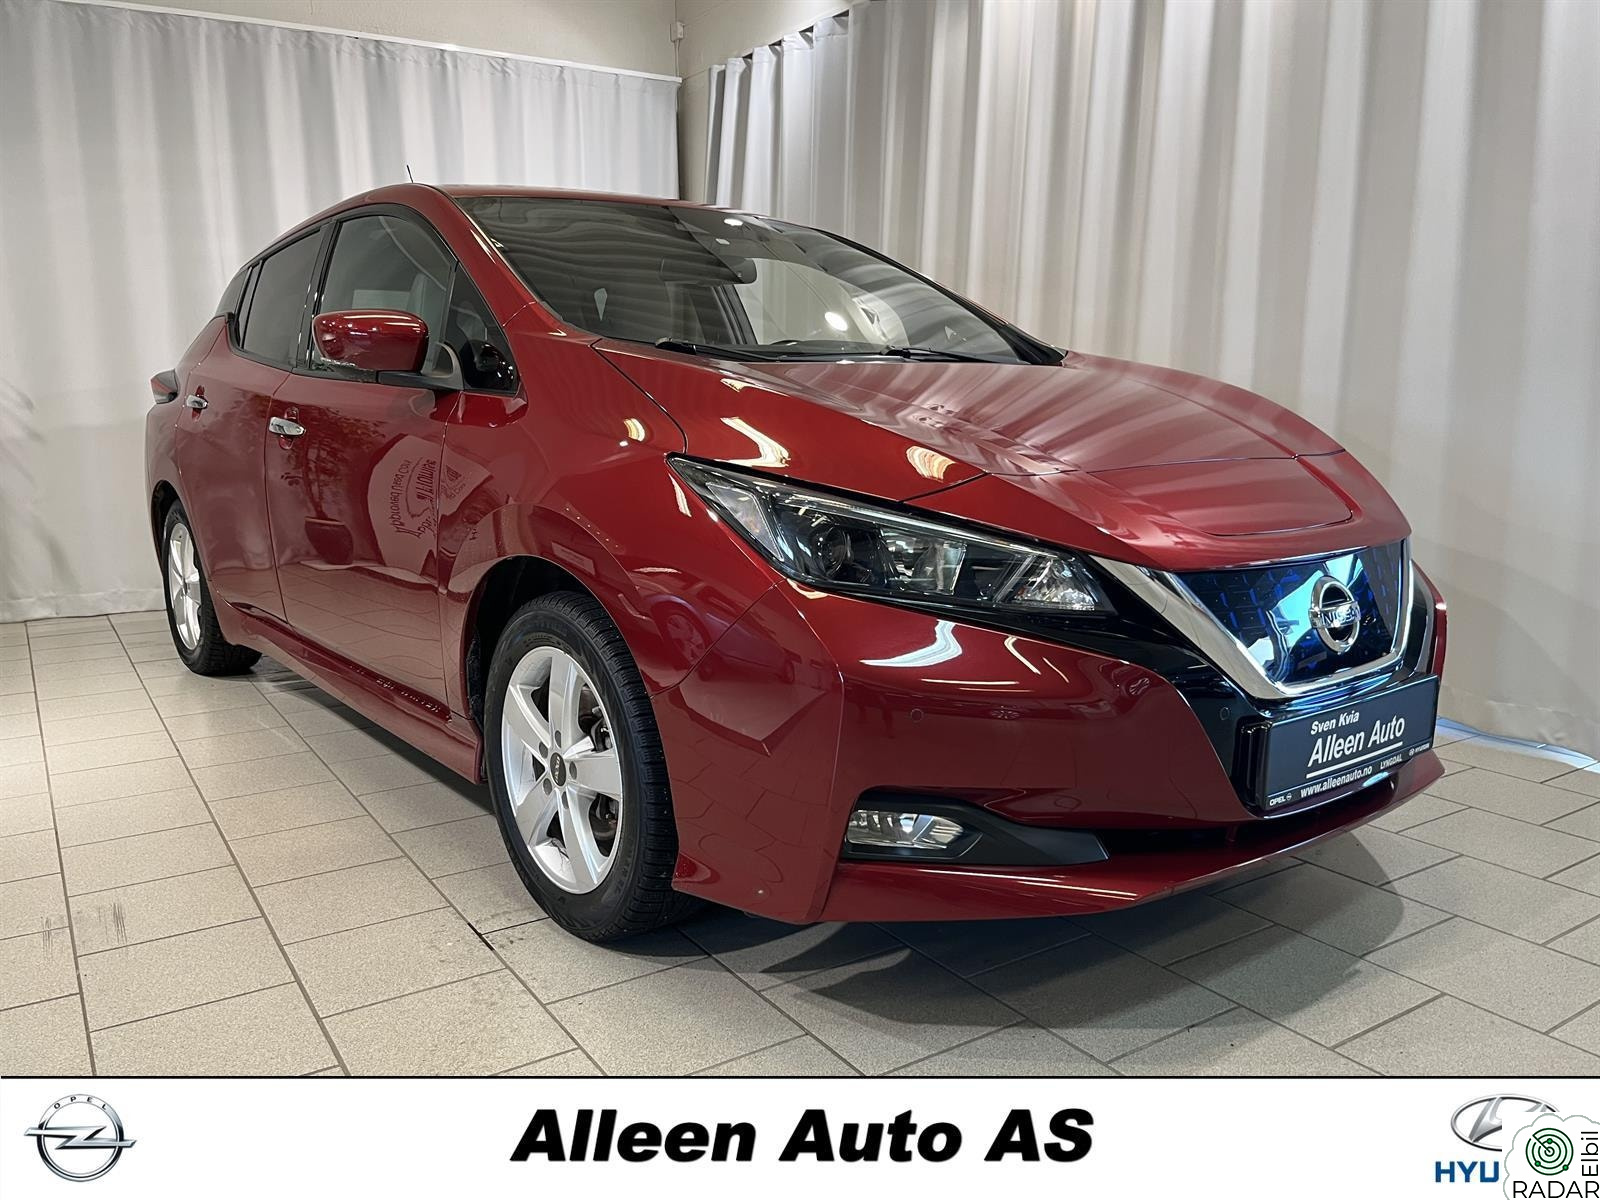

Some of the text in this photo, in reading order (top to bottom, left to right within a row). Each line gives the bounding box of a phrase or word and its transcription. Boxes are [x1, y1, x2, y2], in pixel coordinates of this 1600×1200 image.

[1321, 606, 1361, 626] NISAN
[1310, 710, 1360, 735] Sven Kvia
[1307, 716, 1406, 768] Alleen Auto
[1269, 795, 1287, 806] OPEL
[1300, 766, 1373, 798] www.alleenauto.no
